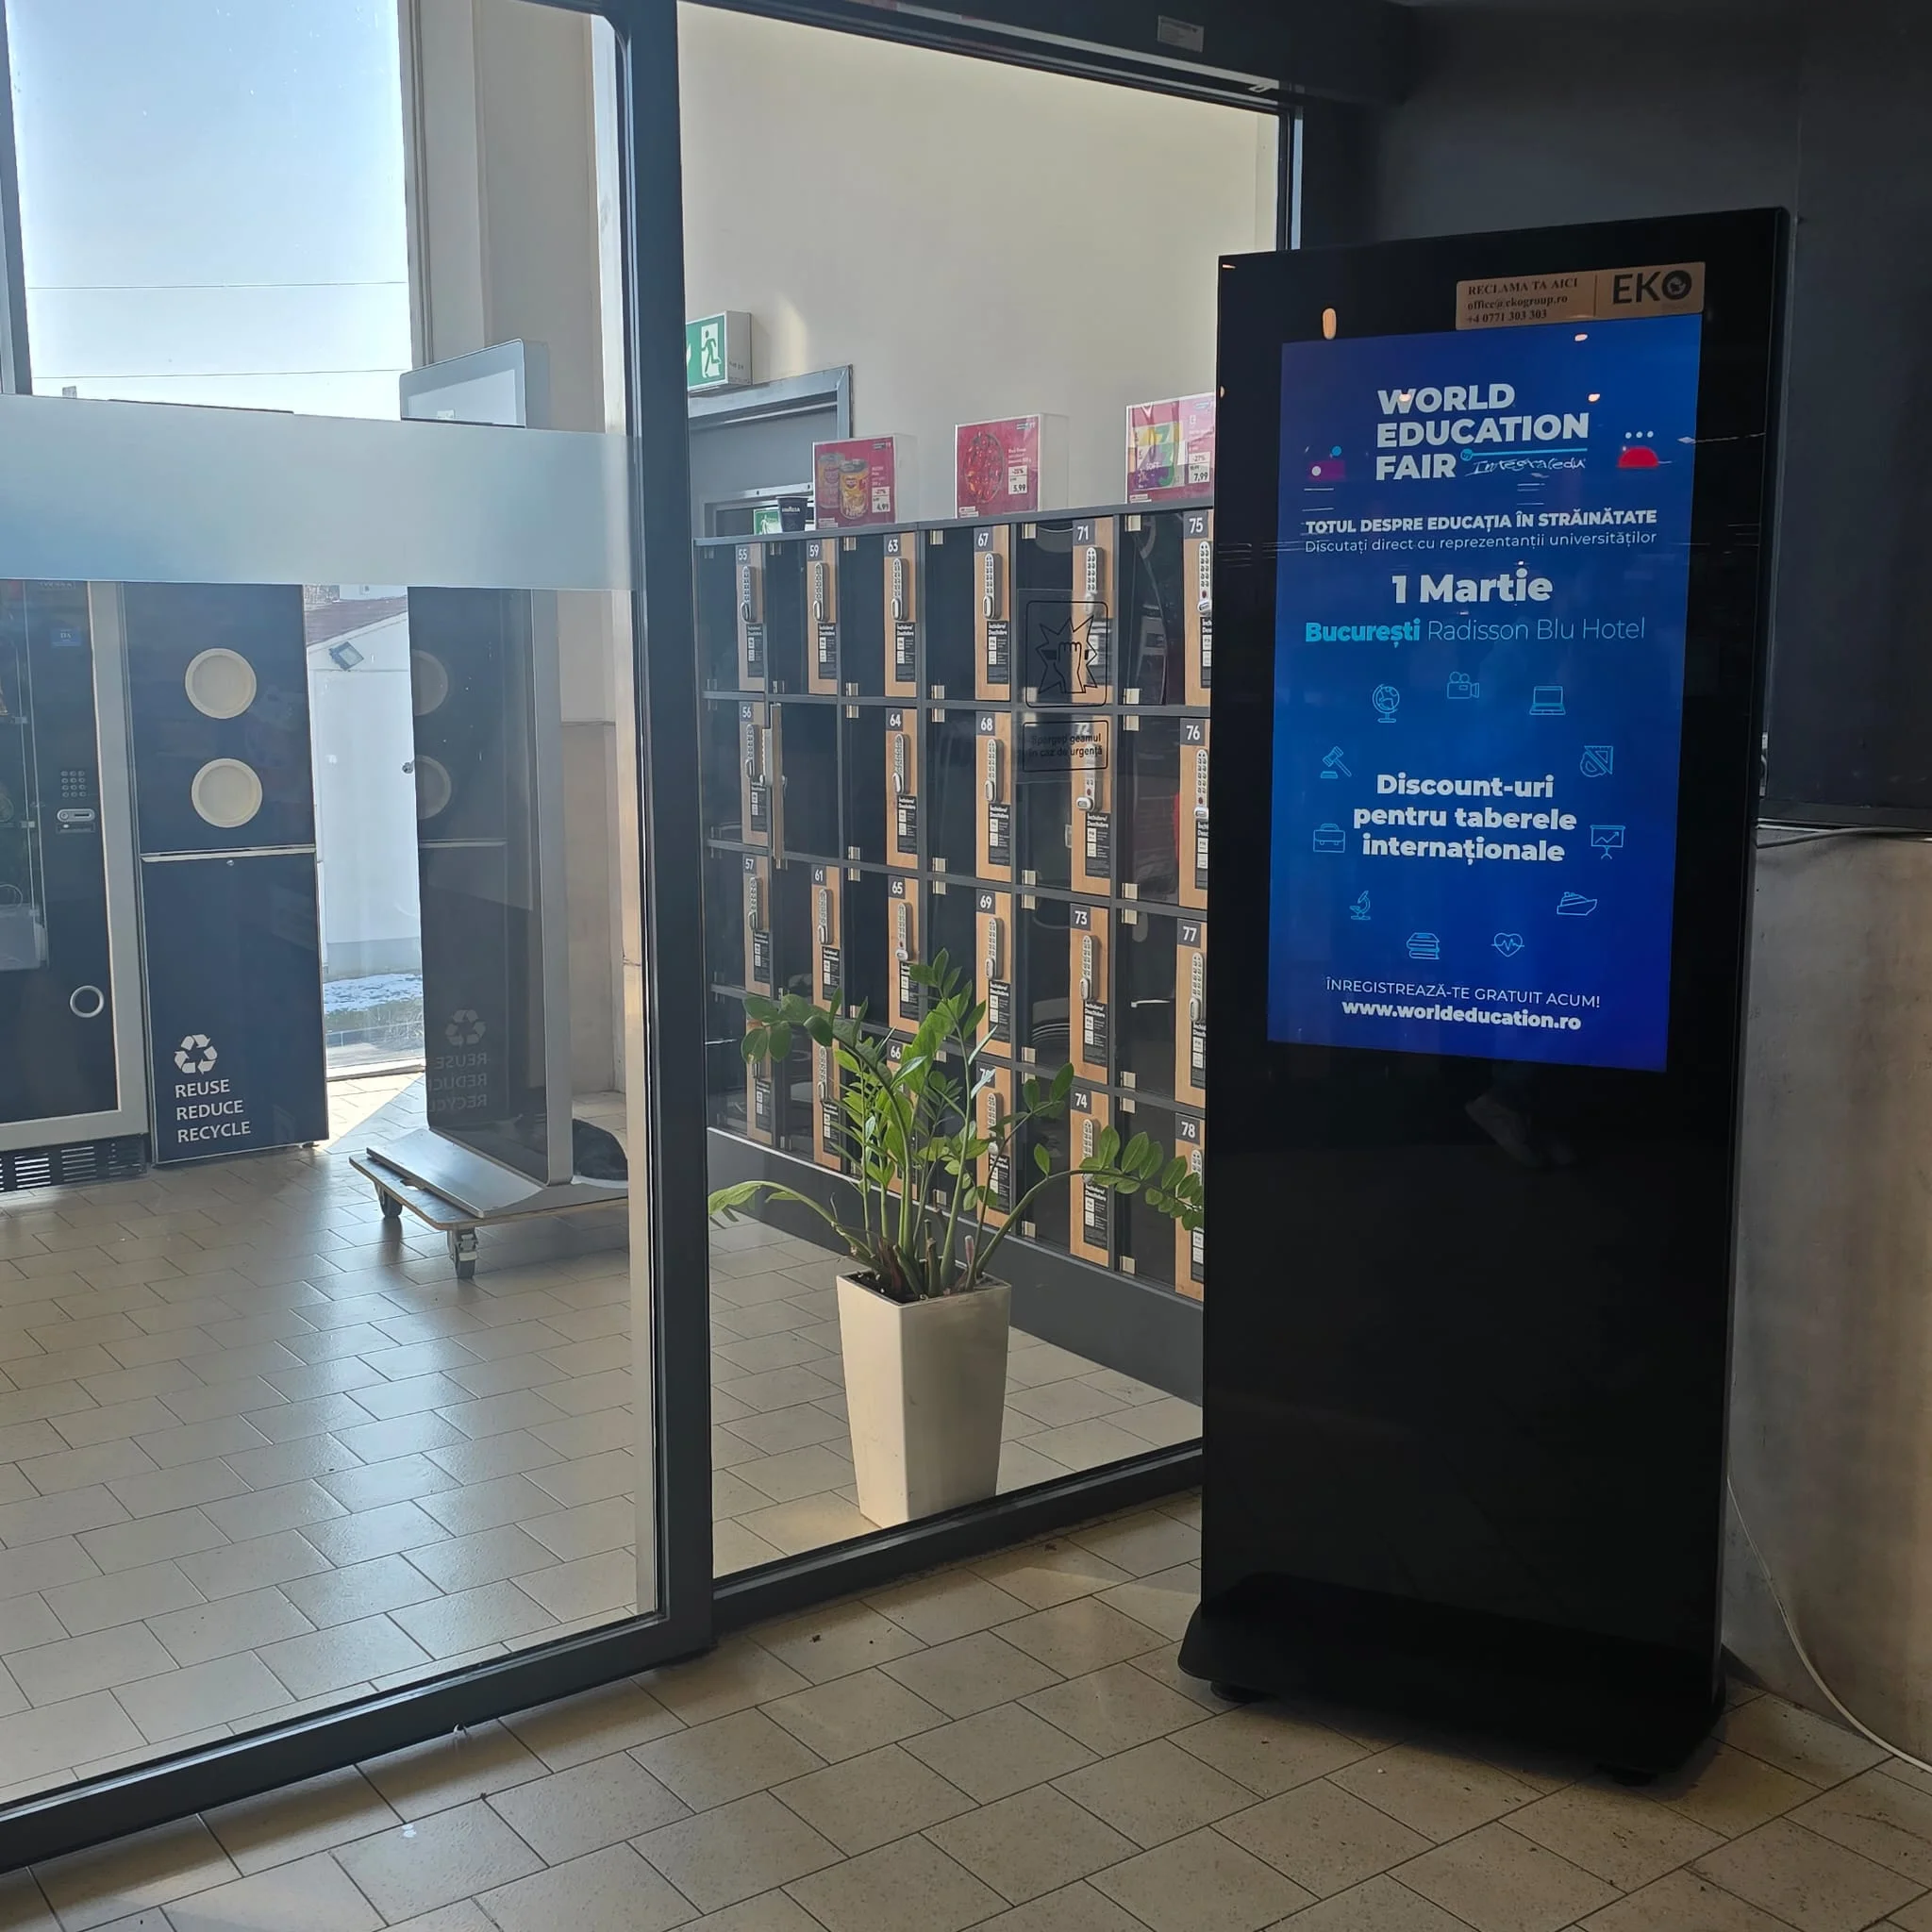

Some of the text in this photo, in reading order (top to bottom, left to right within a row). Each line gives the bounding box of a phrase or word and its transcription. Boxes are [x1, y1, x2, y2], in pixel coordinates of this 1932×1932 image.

[1468, 278, 1578, 295] RECLAMA TA AICI
[1612, 270, 1692, 305] EKO
[1483, 312, 1505, 323] 0771
[1509, 311, 1526, 321] 303
[1530, 309, 1547, 319] 303
[1377, 383, 1516, 415] WORLD
[1376, 412, 1590, 448] EDUCATION
[1375, 453, 1456, 480] FAIR
[1194, 473, 1208, 482] 7,99
[1189, 517, 1204, 534] 75
[1306, 509, 1657, 534] TOTUL DESPRE EDUCAȚIA ÎN STRĂINĂTATE
[978, 533, 989, 547] 67
[1077, 525, 1089, 541] 71
[809, 544, 820, 558] 59
[888, 540, 898, 554] 63
[1305, 531, 1657, 555] Discutați direct cu reprezentanții universităților
[739, 549, 748, 561] 55
[1391, 567, 1553, 604] 1 Martie
[1305, 617, 1645, 648] București Radisson Blu Hotel
[742, 707, 752, 718] 56
[890, 714, 901, 728] 64
[980, 718, 993, 732] 68
[1075, 723, 1091, 736] 72
[1186, 725, 1201, 741] 76
[1070, 733, 1101, 745] geamul
[1376, 773, 1554, 798] Discount-uri
[1353, 807, 1577, 831] pentru taberele
[1362, 833, 1565, 865] internaționale
[745, 859, 754, 871] 57
[814, 870, 824, 883] 61
[891, 881, 903, 896] 65
[980, 895, 992, 909] 69
[1074, 910, 1088, 925] 73
[1182, 926, 1197, 942] 77
[1325, 975, 1601, 1008] ÎNREGISTREAZĂ-TE GRATUIT ACUM!
[1342, 1000, 1582, 1031] www.worldeducation.ro
[891, 1045, 901, 1059] 66
[175, 1079, 230, 1098] REUSE
[1075, 1092, 1088, 1108] 74
[176, 1100, 244, 1121] REDUCE
[177, 1121, 251, 1143] RECYCLE
[1181, 1122, 1196, 1138] 78
